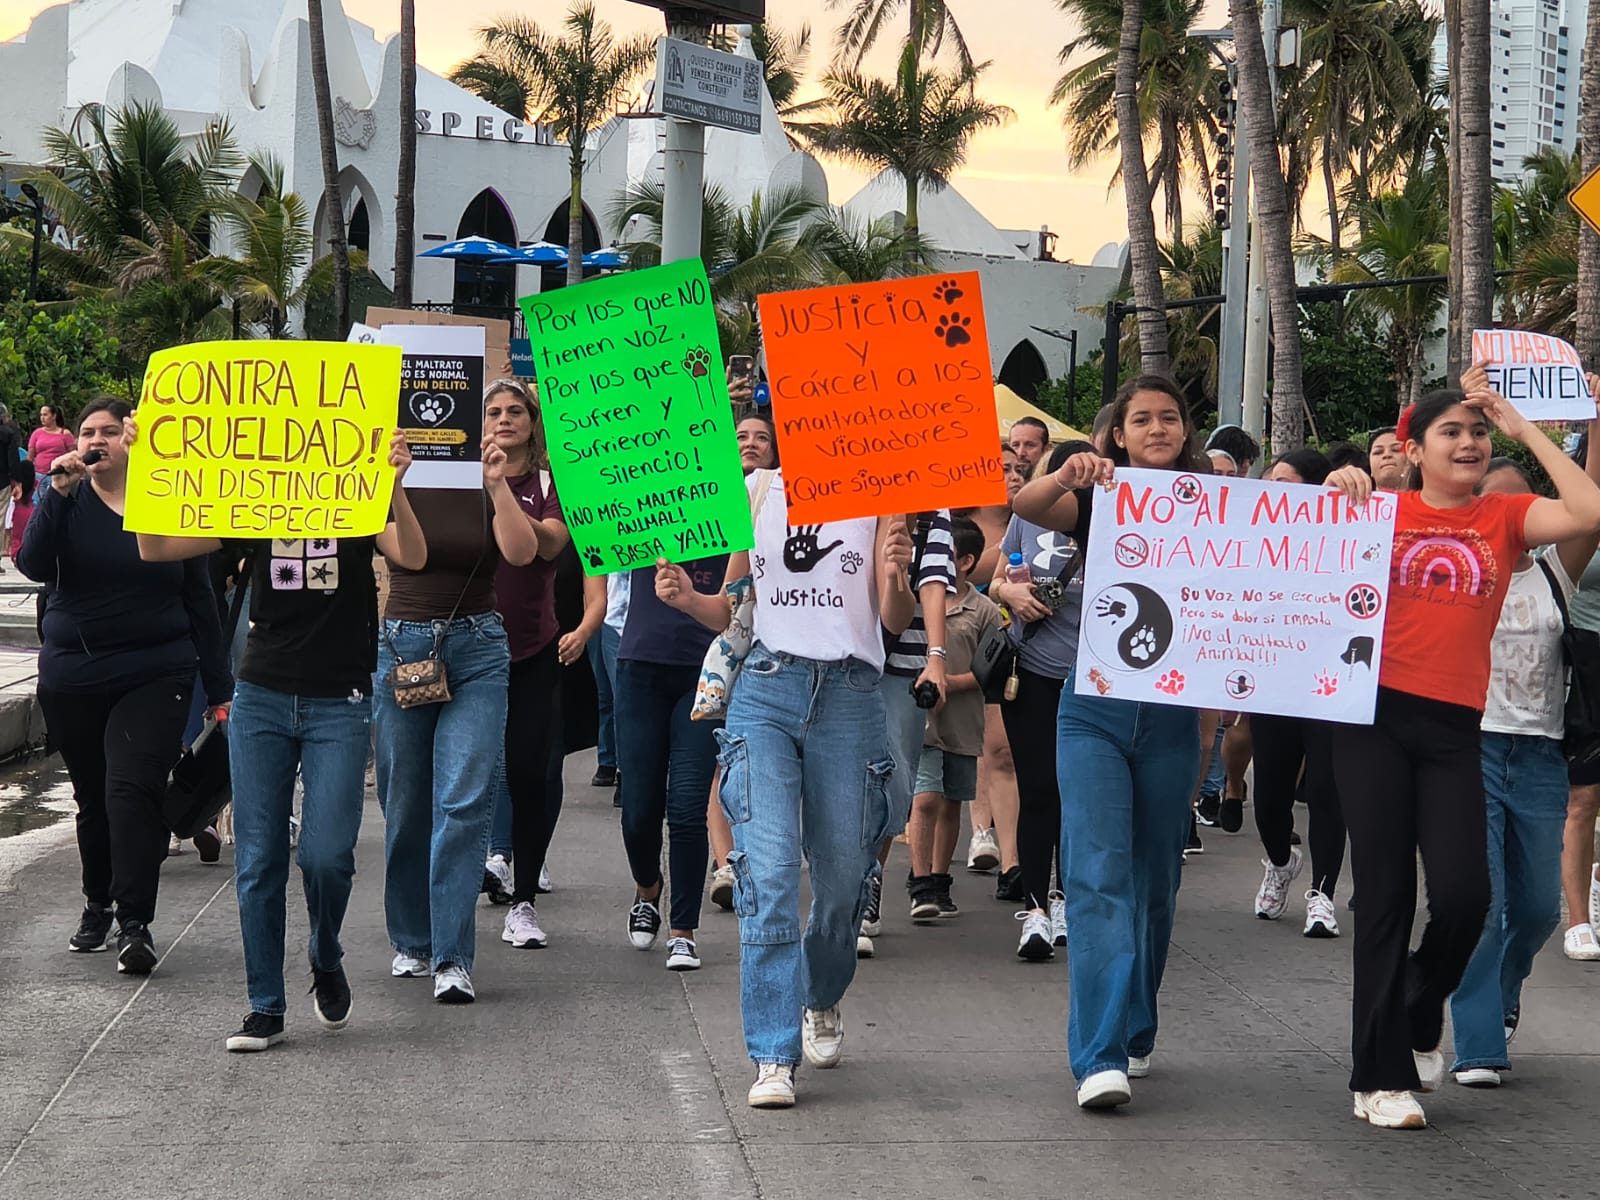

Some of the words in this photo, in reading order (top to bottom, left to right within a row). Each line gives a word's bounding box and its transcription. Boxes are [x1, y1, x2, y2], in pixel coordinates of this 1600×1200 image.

[713, 72, 733, 85] RENTAR
[715, 61, 742, 76] COMPRAR
[531, 302, 577, 334] Por
[586, 299, 624, 325] los
[634, 292, 673, 326] que
[678, 278, 706, 307] NO
[774, 291, 928, 339] Justicia
[511, 353, 533, 361] Helad
[541, 338, 615, 369] tienen
[1472, 331, 1505, 365] NO
[1510, 332, 1580, 366] HABLAN
[402, 359, 412, 369] EL
[415, 360, 463, 370] MALTRATO
[414, 370, 426, 379] ES
[776, 369, 880, 400] Cárcel
[896, 368, 918, 387] a
[934, 359, 982, 384] los
[142, 359, 299, 408] ¡CONTRA
[319, 360, 366, 410] LA
[399, 379, 409, 389] S
[413, 380, 428, 390] UN
[432, 380, 470, 390] DELITO.
[544, 376, 580, 404] Por
[590, 369, 625, 395] los
[634, 359, 679, 390] que
[560, 403, 640, 432] Sufren
[149, 415, 385, 469] CRUELDAD!
[563, 428, 671, 464] Sufrieron
[689, 418, 717, 438] en
[146, 468, 203, 498] SIN
[219, 465, 380, 501] DISTINCIÓN
[785, 476, 843, 507] ¡Que
[180, 503, 214, 529] DE
[230, 503, 353, 531] ESPECIE
[565, 505, 594, 529] ¡NO
[598, 499, 632, 522] MÁS
[637, 481, 719, 513] MALTRATO
[616, 507, 687, 537] ANIMAL!
[611, 539, 665, 567] BASTA
[673, 519, 729, 555] YA!!!
[770, 586, 844, 608] Justicia
[1180, 606, 1206, 619] Pero
[1232, 608, 1258, 624] dolor
[1216, 628, 1232, 645] al
